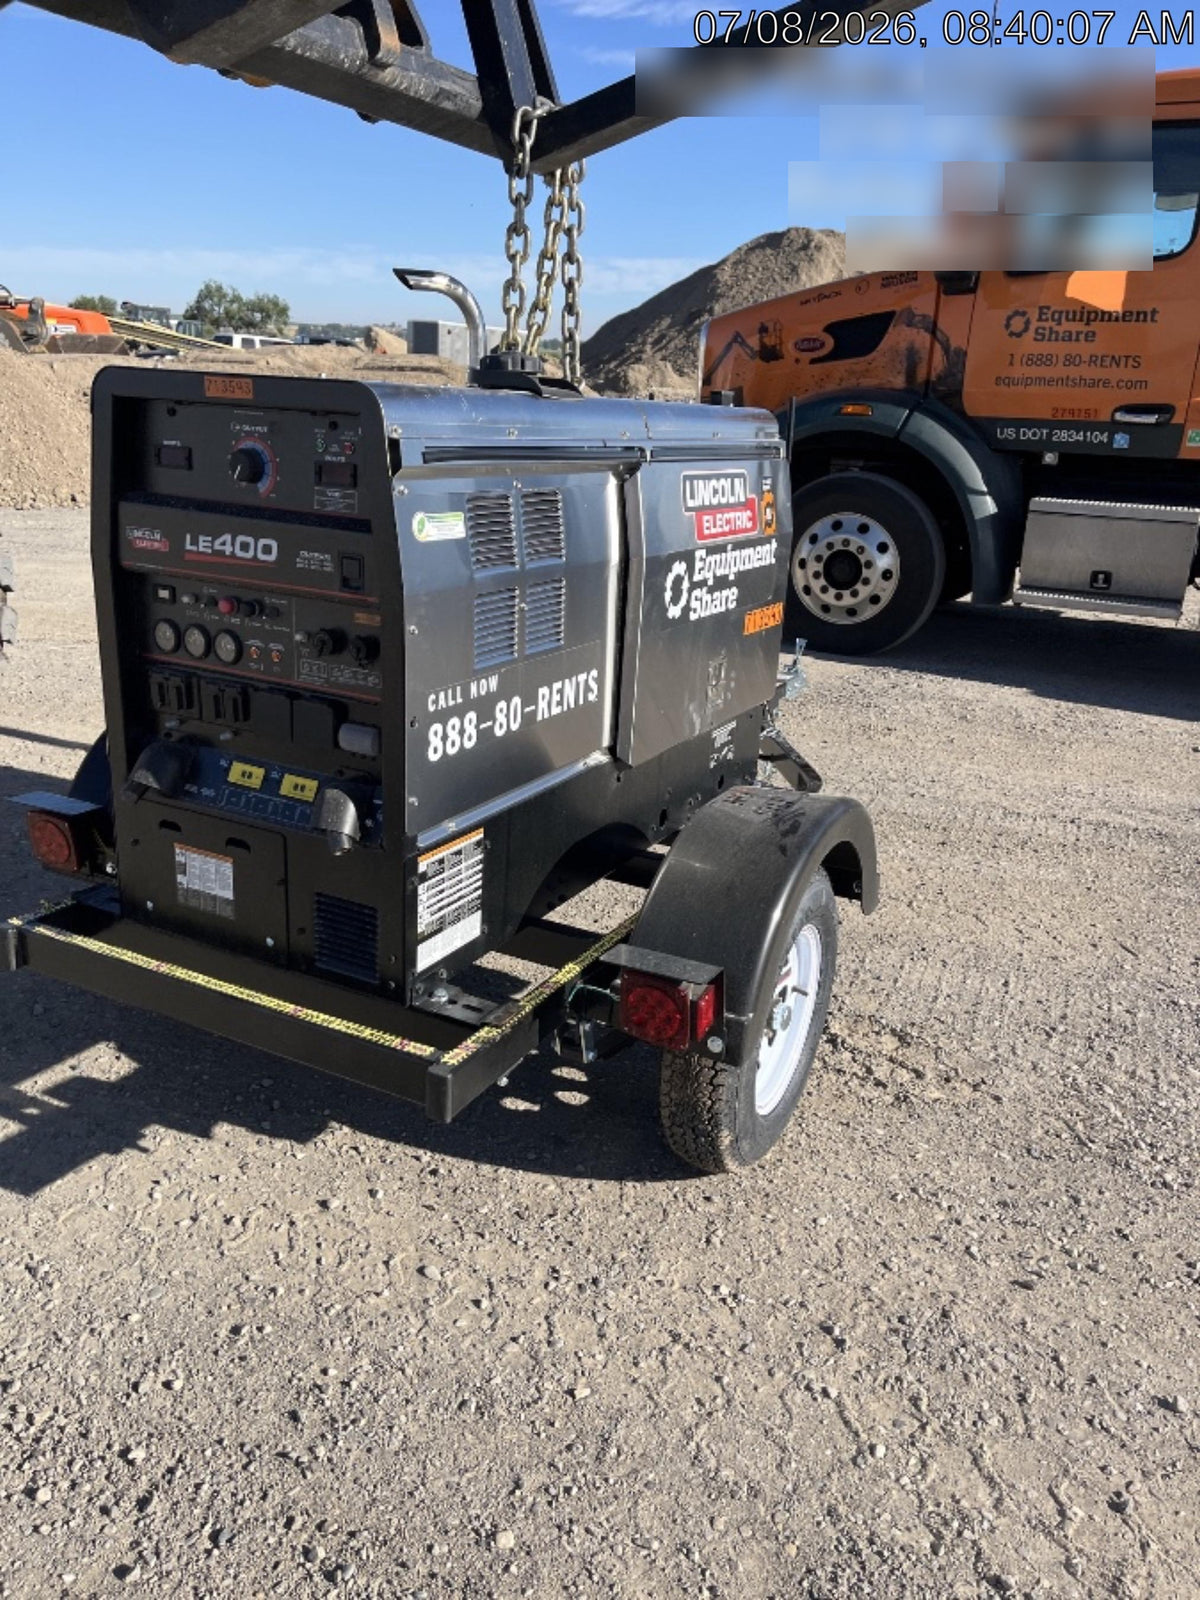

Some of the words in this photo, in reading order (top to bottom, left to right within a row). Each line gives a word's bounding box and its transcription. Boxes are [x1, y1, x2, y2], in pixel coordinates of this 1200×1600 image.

[1036, 305, 1160, 327] Equipment
[1032, 326, 1097, 342] Share
[1008, 353, 1015, 367] 1
[1019, 353, 1059, 368] (888)
[1062, 354, 1142, 369] 80-RENTS
[994, 373, 1149, 391] equipmentshare.com
[996, 428, 1016, 439] US
[1019, 428, 1049, 440] DOT
[1052, 429, 1109, 443] 2834104
[686, 477, 746, 507] LINCOLN
[702, 510, 753, 535] ELECTRIC
[184, 533, 278, 562] LE400
[693, 538, 778, 586] Equipment
[689, 586, 739, 621] Share
[427, 686, 463, 712] CALL
[470, 674, 499, 699] NOW
[427, 668, 599, 762] 888-80-RENTS
